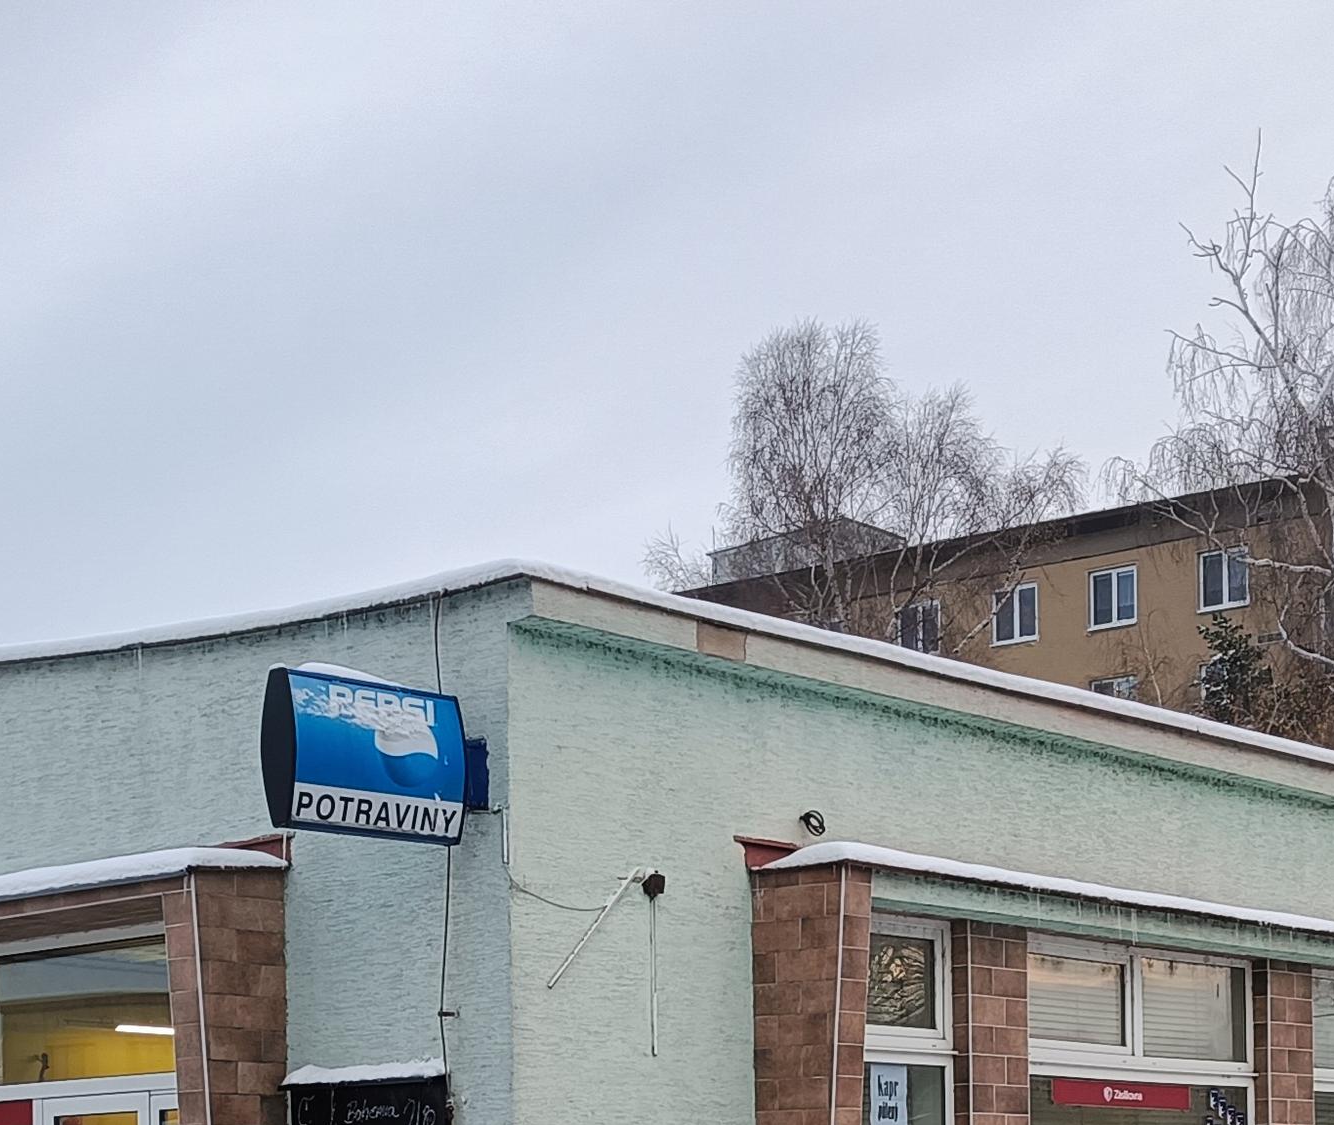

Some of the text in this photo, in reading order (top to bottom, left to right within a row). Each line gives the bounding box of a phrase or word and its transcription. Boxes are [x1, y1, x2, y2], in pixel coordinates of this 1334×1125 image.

[328, 684, 435, 727] PEPSI
[295, 791, 457, 834] POTRAVINY
[877, 1074, 899, 1101] Kapr
